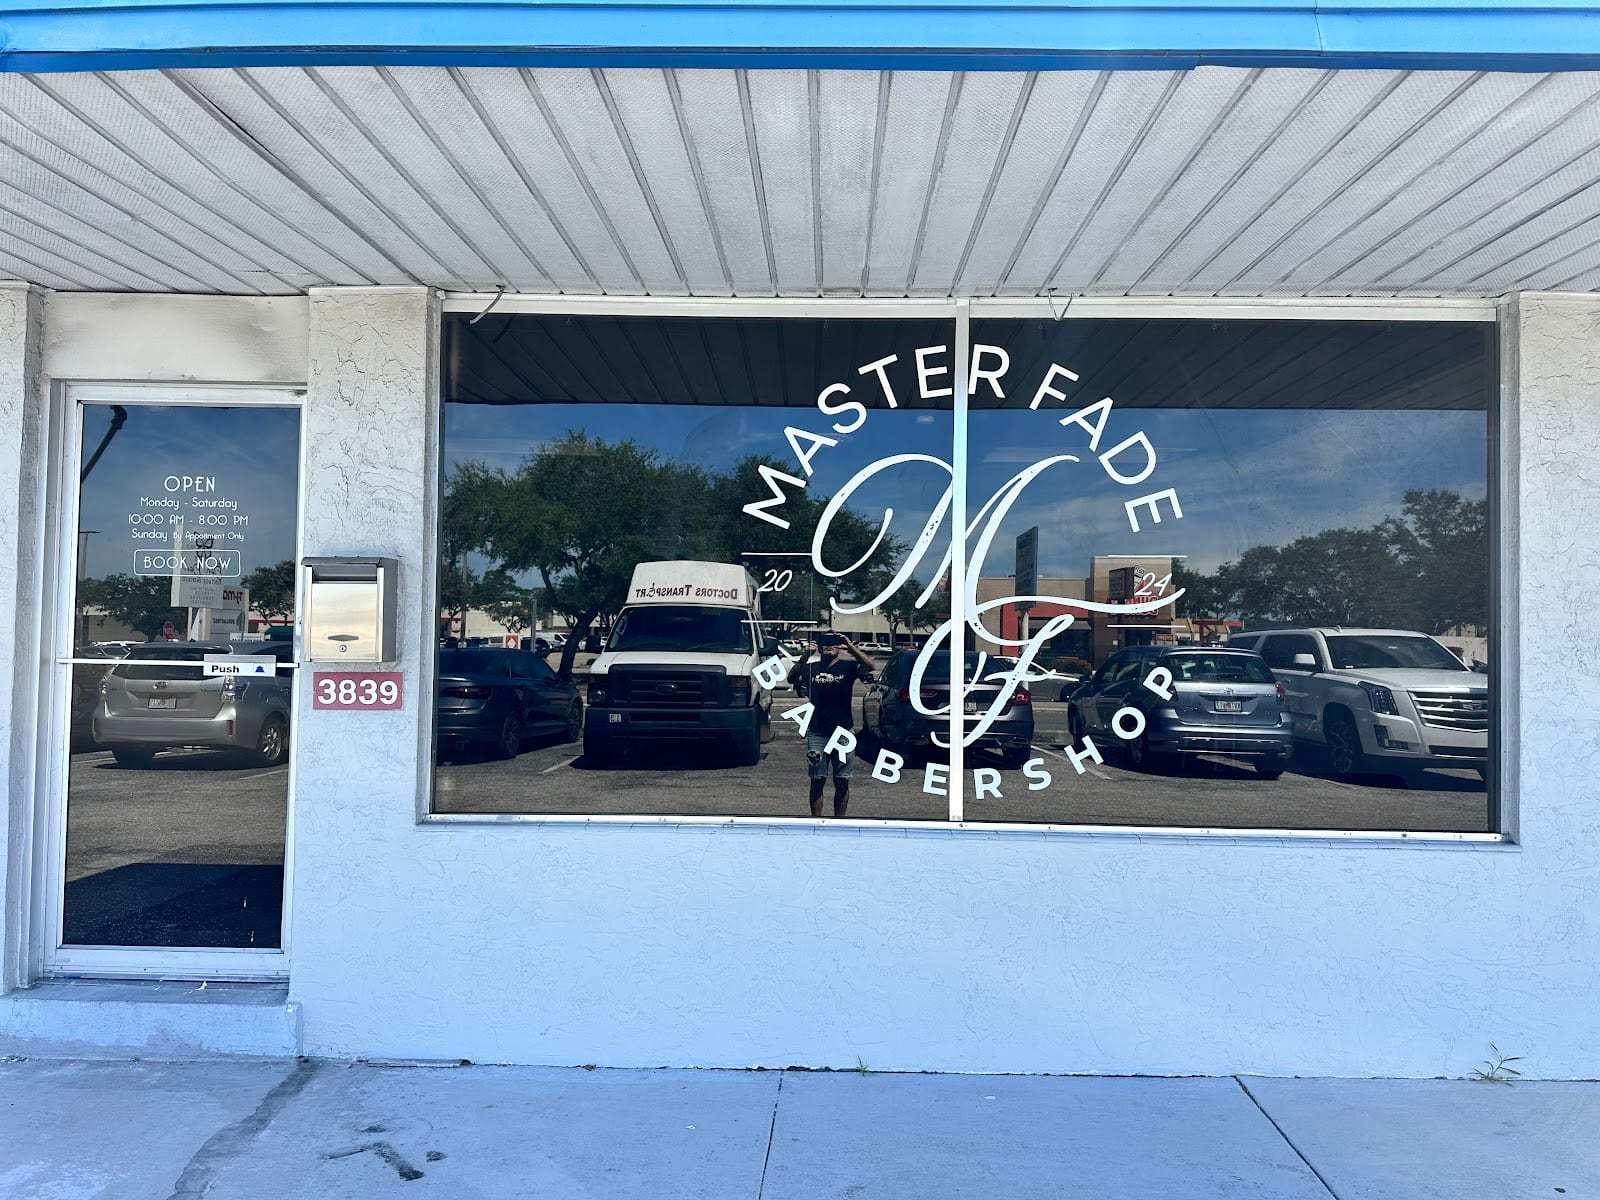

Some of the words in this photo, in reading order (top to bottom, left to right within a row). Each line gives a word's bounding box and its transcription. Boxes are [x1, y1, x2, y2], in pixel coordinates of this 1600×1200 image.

[742, 344, 1010, 530] MASTER
[1028, 363, 1183, 533] FADE
[164, 475, 215, 492] OPEN
[140, 496, 179, 510] Monday
[192, 496, 237, 510] Saturday
[169, 514, 184, 525] AM
[233, 515, 248, 526] PM
[131, 528, 168, 542] Sunday
[173, 531, 182, 541] By
[227, 531, 244, 542] Only
[143, 556, 188, 569] BOOK
[196, 556, 231, 570] NOW
[756, 569, 793, 592] 20
[1134, 572, 1173, 596] 24
[211, 664, 240, 674] Push
[317, 678, 398, 705] 3839
[752, 655, 1173, 800] BARBERSHOP
